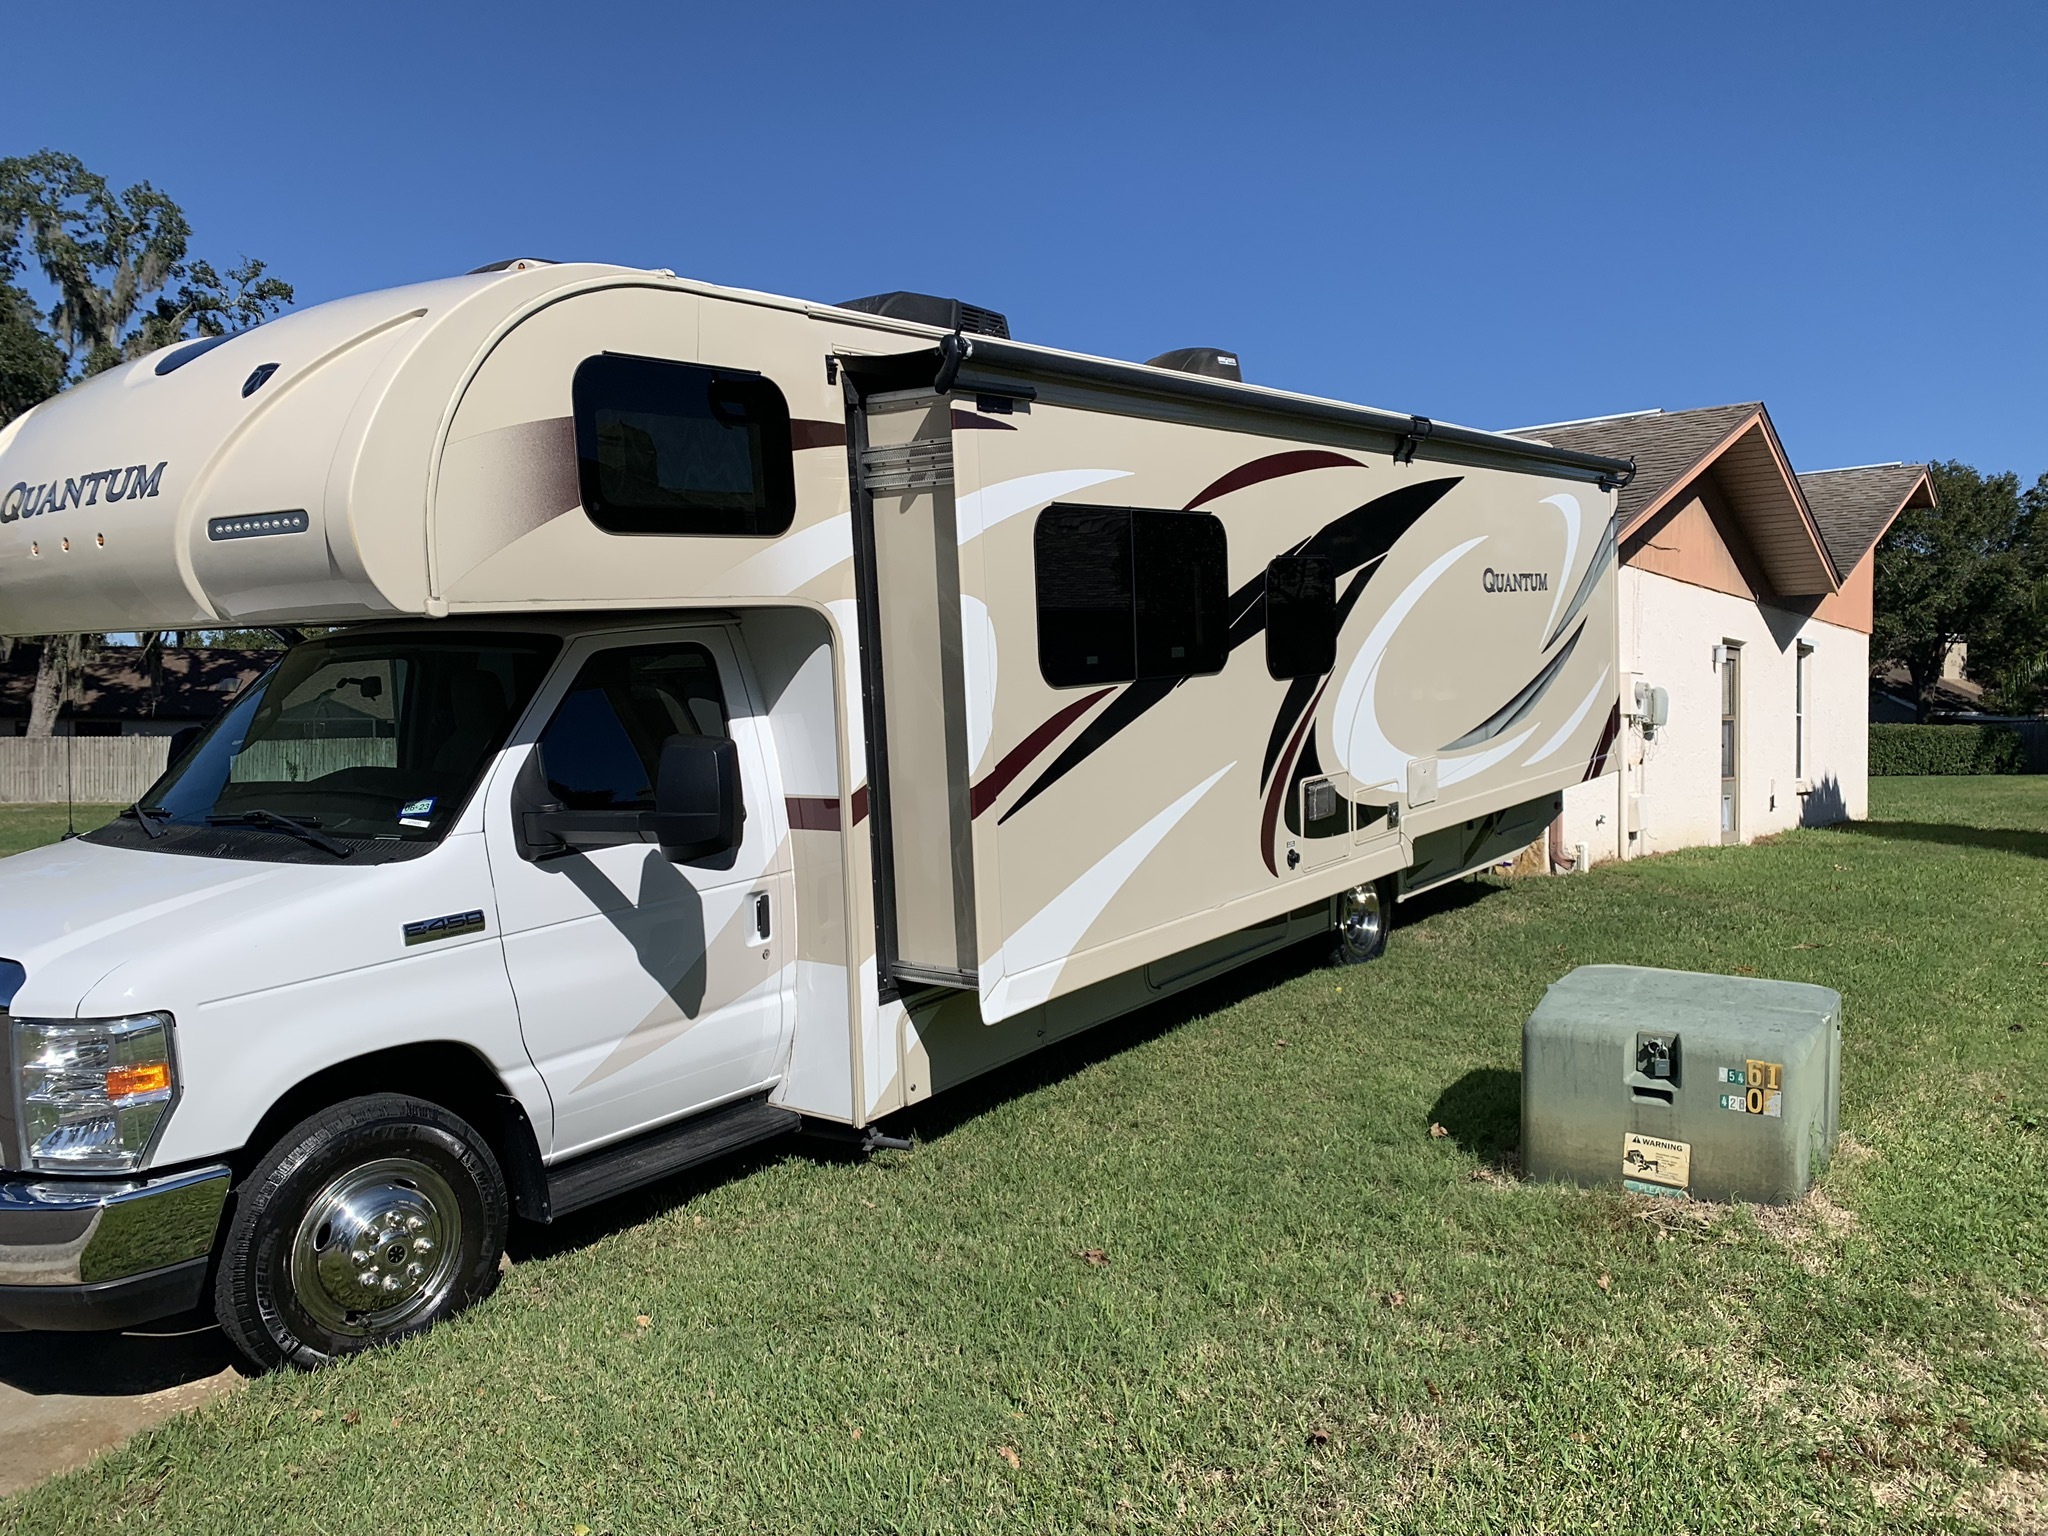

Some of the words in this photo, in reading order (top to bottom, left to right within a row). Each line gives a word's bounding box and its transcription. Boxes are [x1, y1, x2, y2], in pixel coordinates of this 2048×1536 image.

[0, 461, 168, 524] QUANTUM
[1482, 567, 1548, 593] QUANTUM
[1642, 1138, 1683, 1152] WARNING
